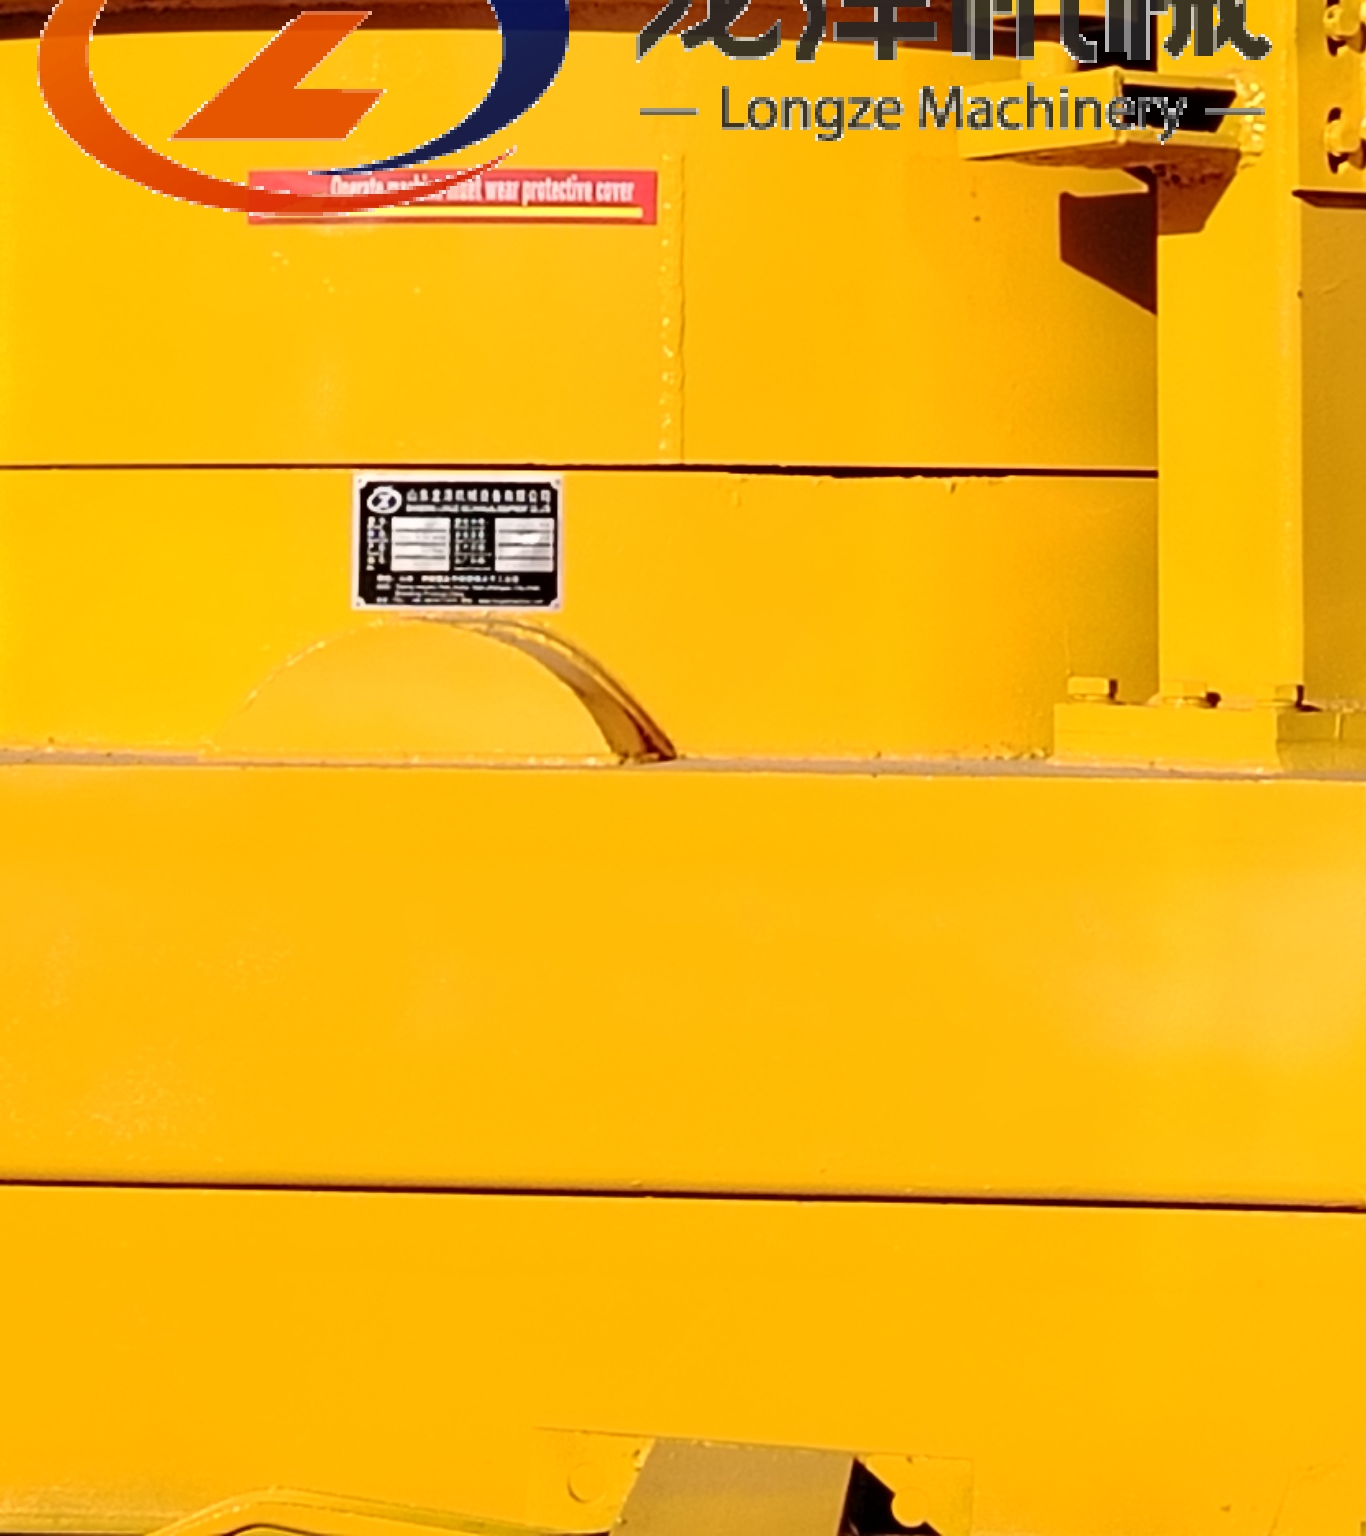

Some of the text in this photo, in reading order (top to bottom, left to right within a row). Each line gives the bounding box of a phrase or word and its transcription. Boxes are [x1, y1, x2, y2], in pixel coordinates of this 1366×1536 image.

[484, 180, 520, 203] wear
[522, 175, 594, 208] protective
[596, 180, 635, 204] cover
